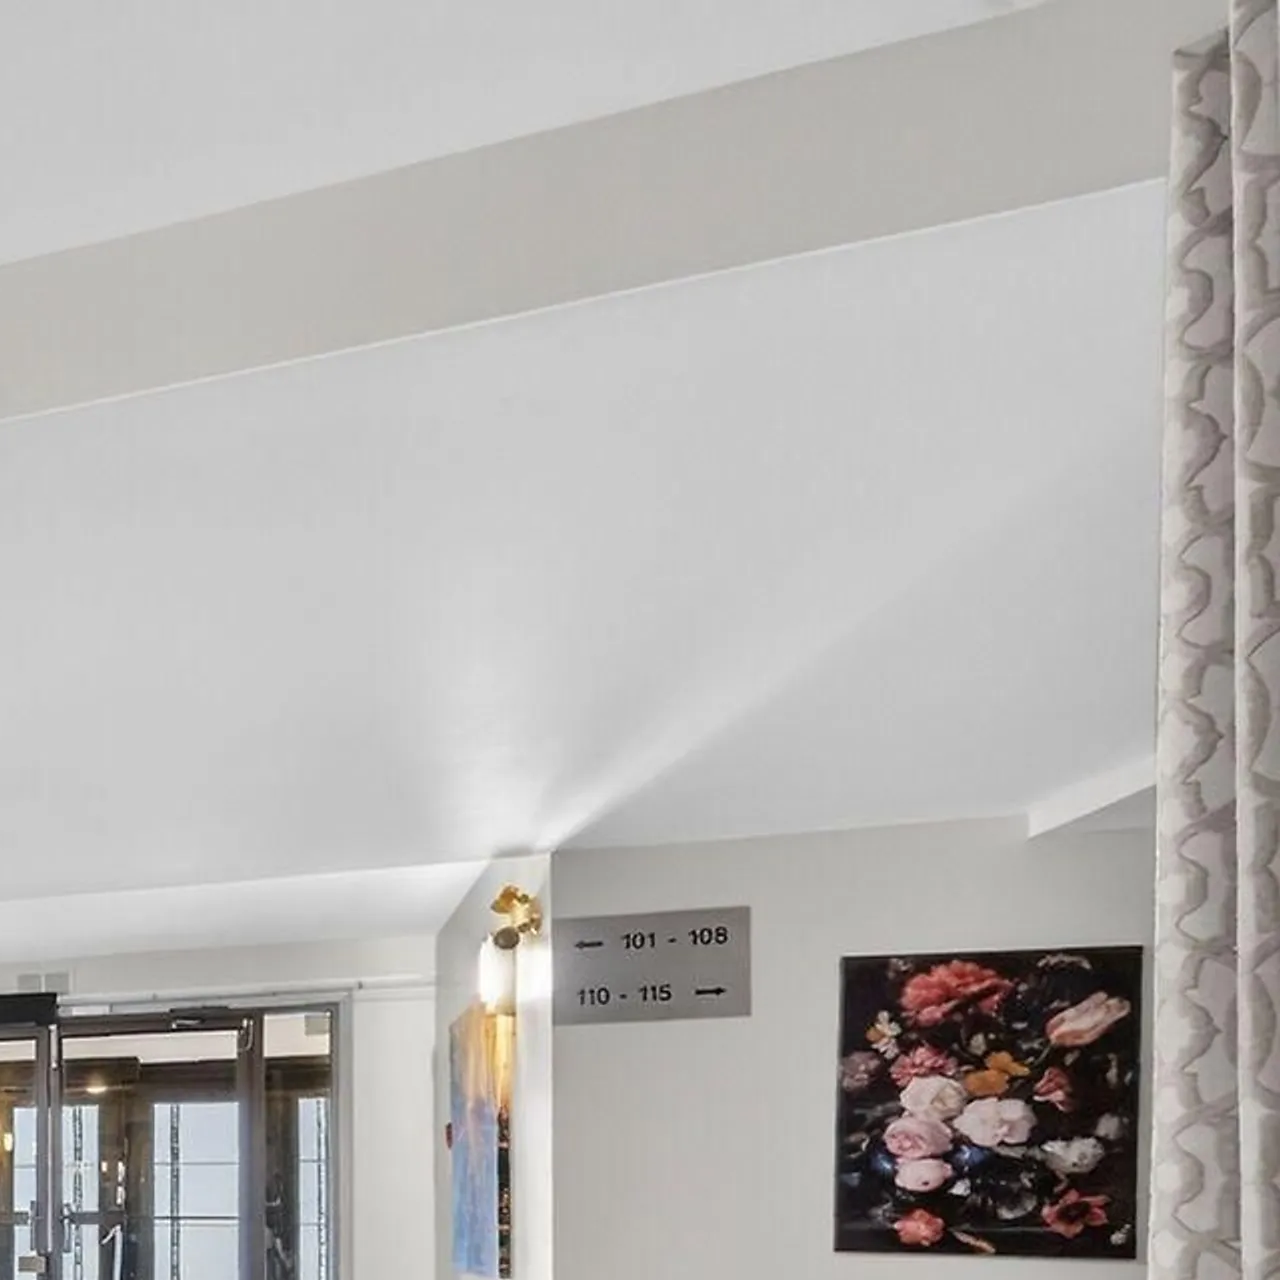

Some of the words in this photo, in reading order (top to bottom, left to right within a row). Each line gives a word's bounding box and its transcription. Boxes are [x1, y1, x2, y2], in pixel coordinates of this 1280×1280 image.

[620, 931, 656, 950] 101
[688, 926, 729, 946] 108
[577, 987, 610, 1006] 110
[638, 983, 673, 1002] 115
